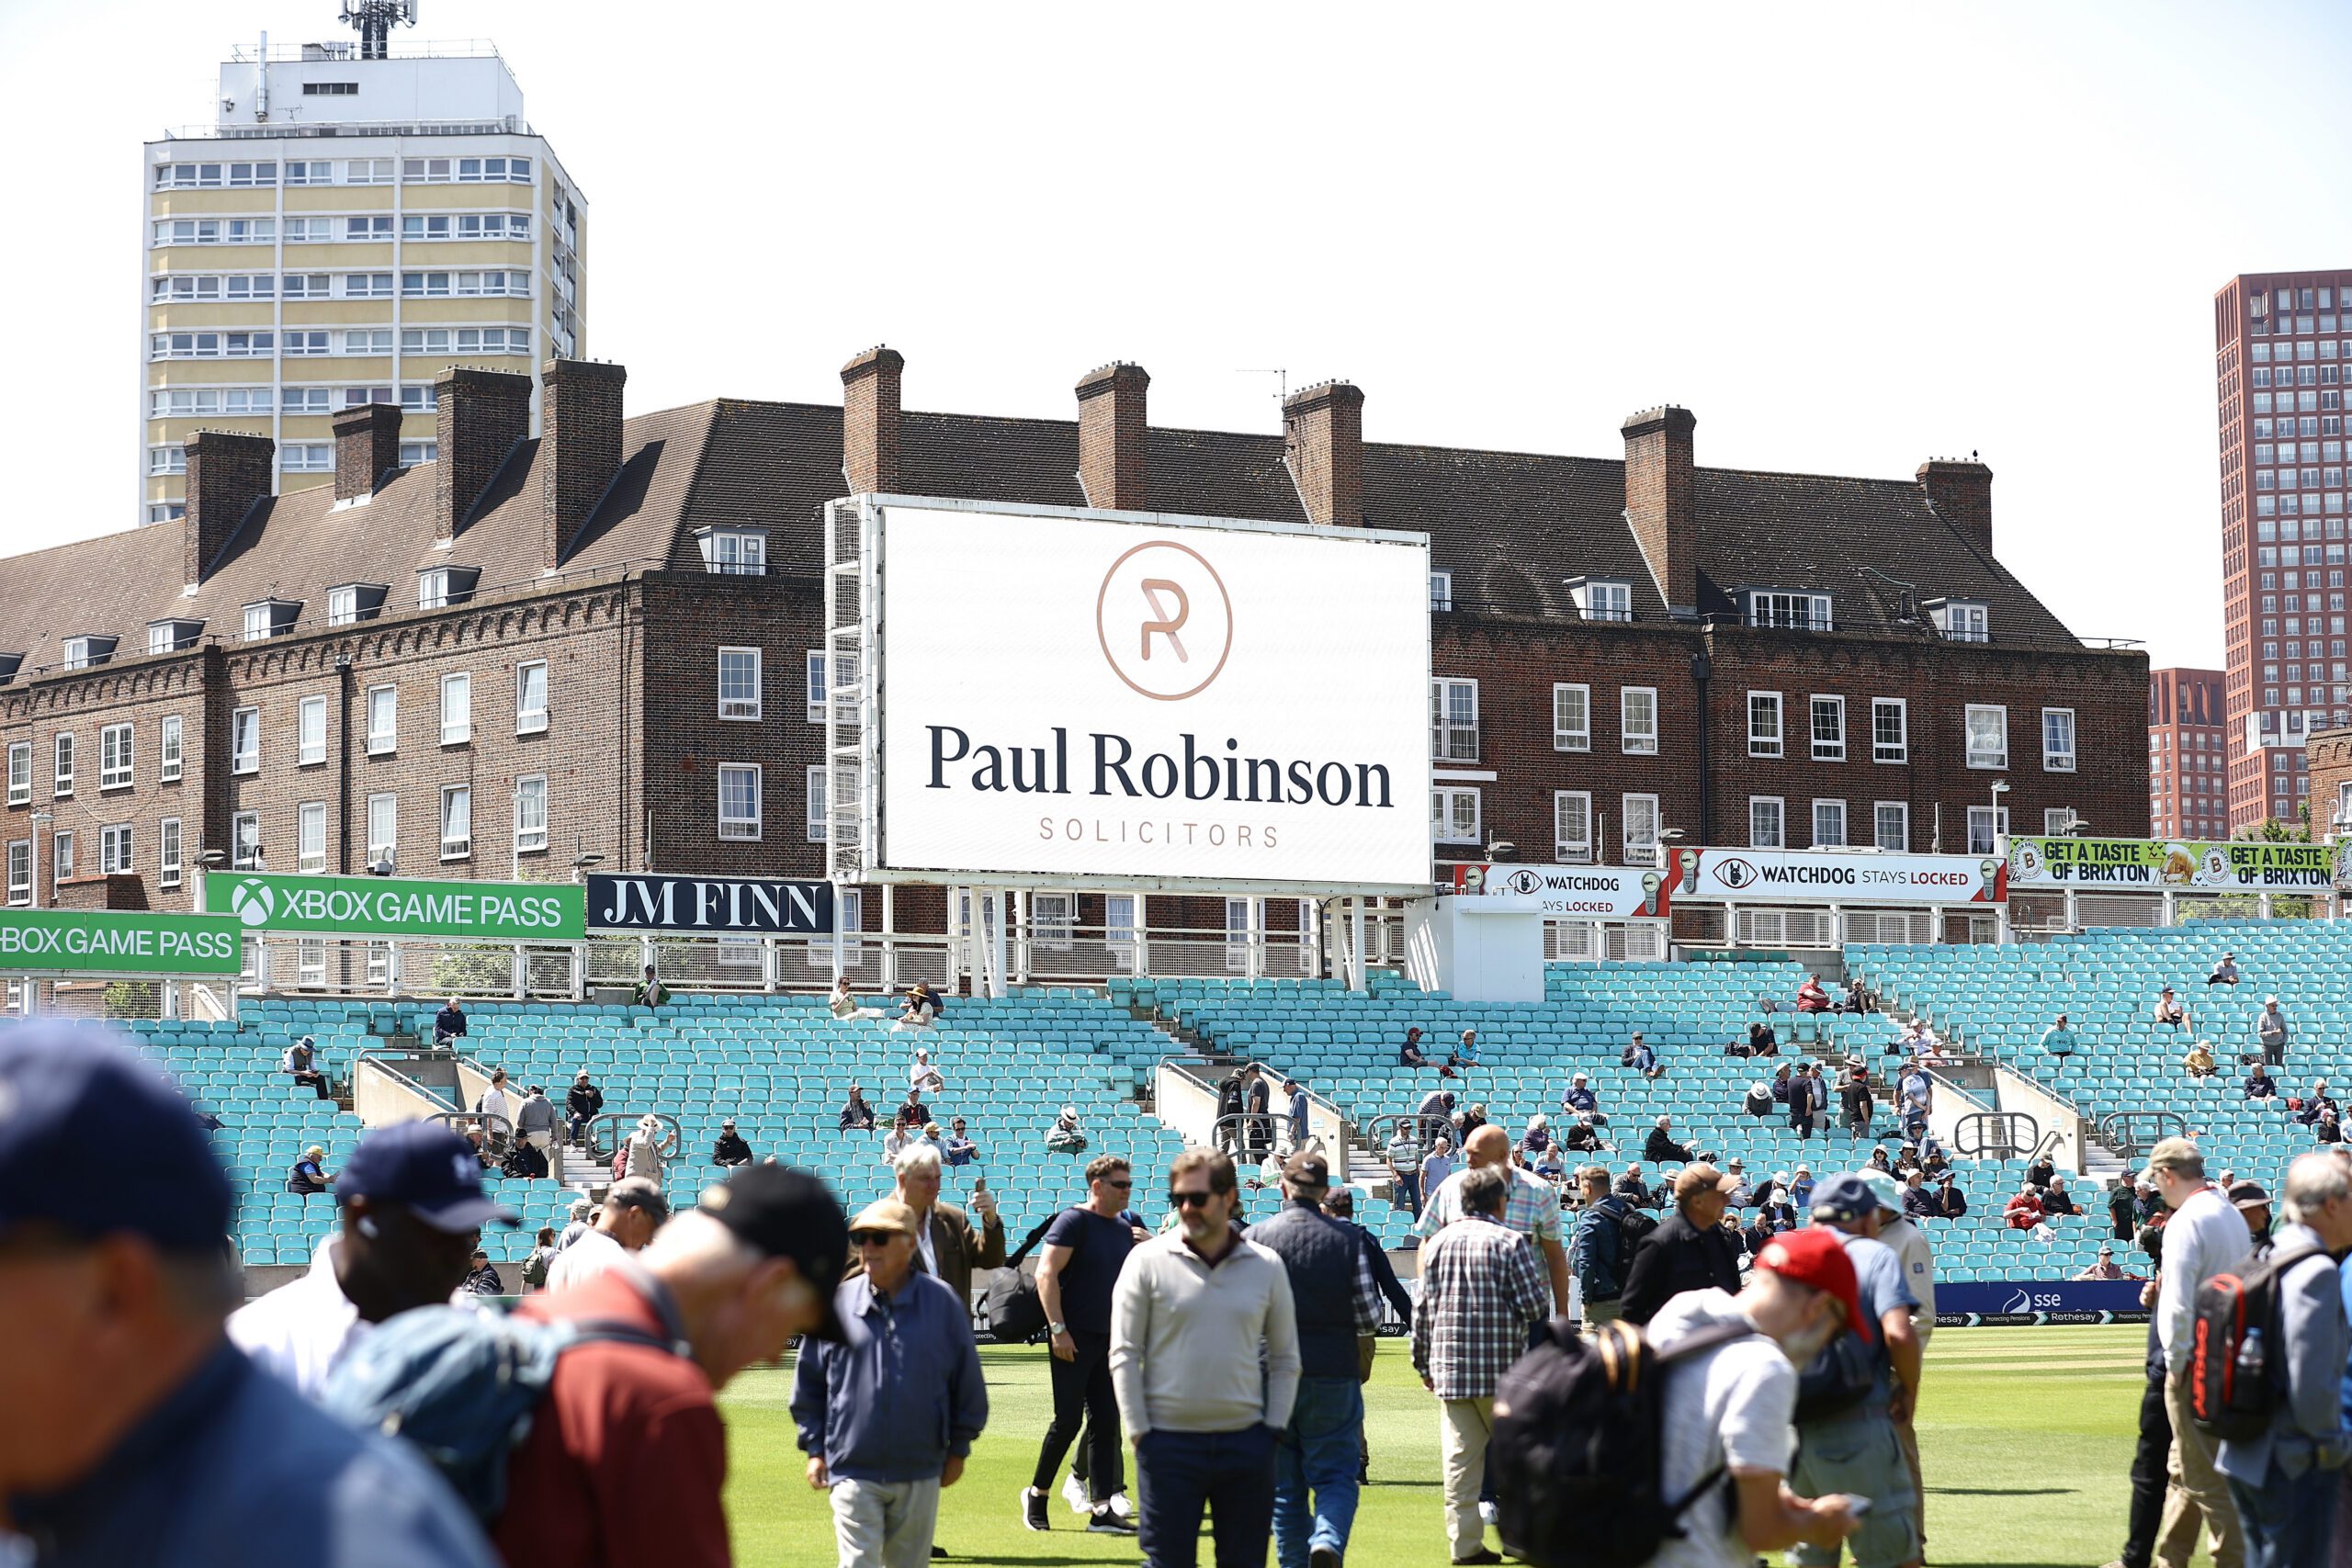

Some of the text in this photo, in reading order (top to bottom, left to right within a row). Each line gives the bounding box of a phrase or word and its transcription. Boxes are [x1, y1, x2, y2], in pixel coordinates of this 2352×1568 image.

[924, 725, 1395, 808] Paul Robinson
[1039, 817, 1277, 849] SOLICITORS
[2044, 841, 2141, 862] GET A TASTE
[2230, 846, 2323, 866] GET A TASTE
[1761, 865, 1969, 886] WATCHDOG STAYS LOCKED
[2052, 862, 2150, 882] OF BRIXTON
[2237, 866, 2331, 886] OF BRIXTON
[1545, 875, 1620, 891] WATCHDOG
[281, 888, 561, 928] XBOX GAME PASS
[604, 879, 822, 929] JM FINN
[1544, 900, 1613, 912] AYS LOCKED
[0, 927, 232, 958] BOX GAME PASS
[1934, 1314, 1963, 1325] hesay
[2051, 1313, 2096, 1323] Rothesay
